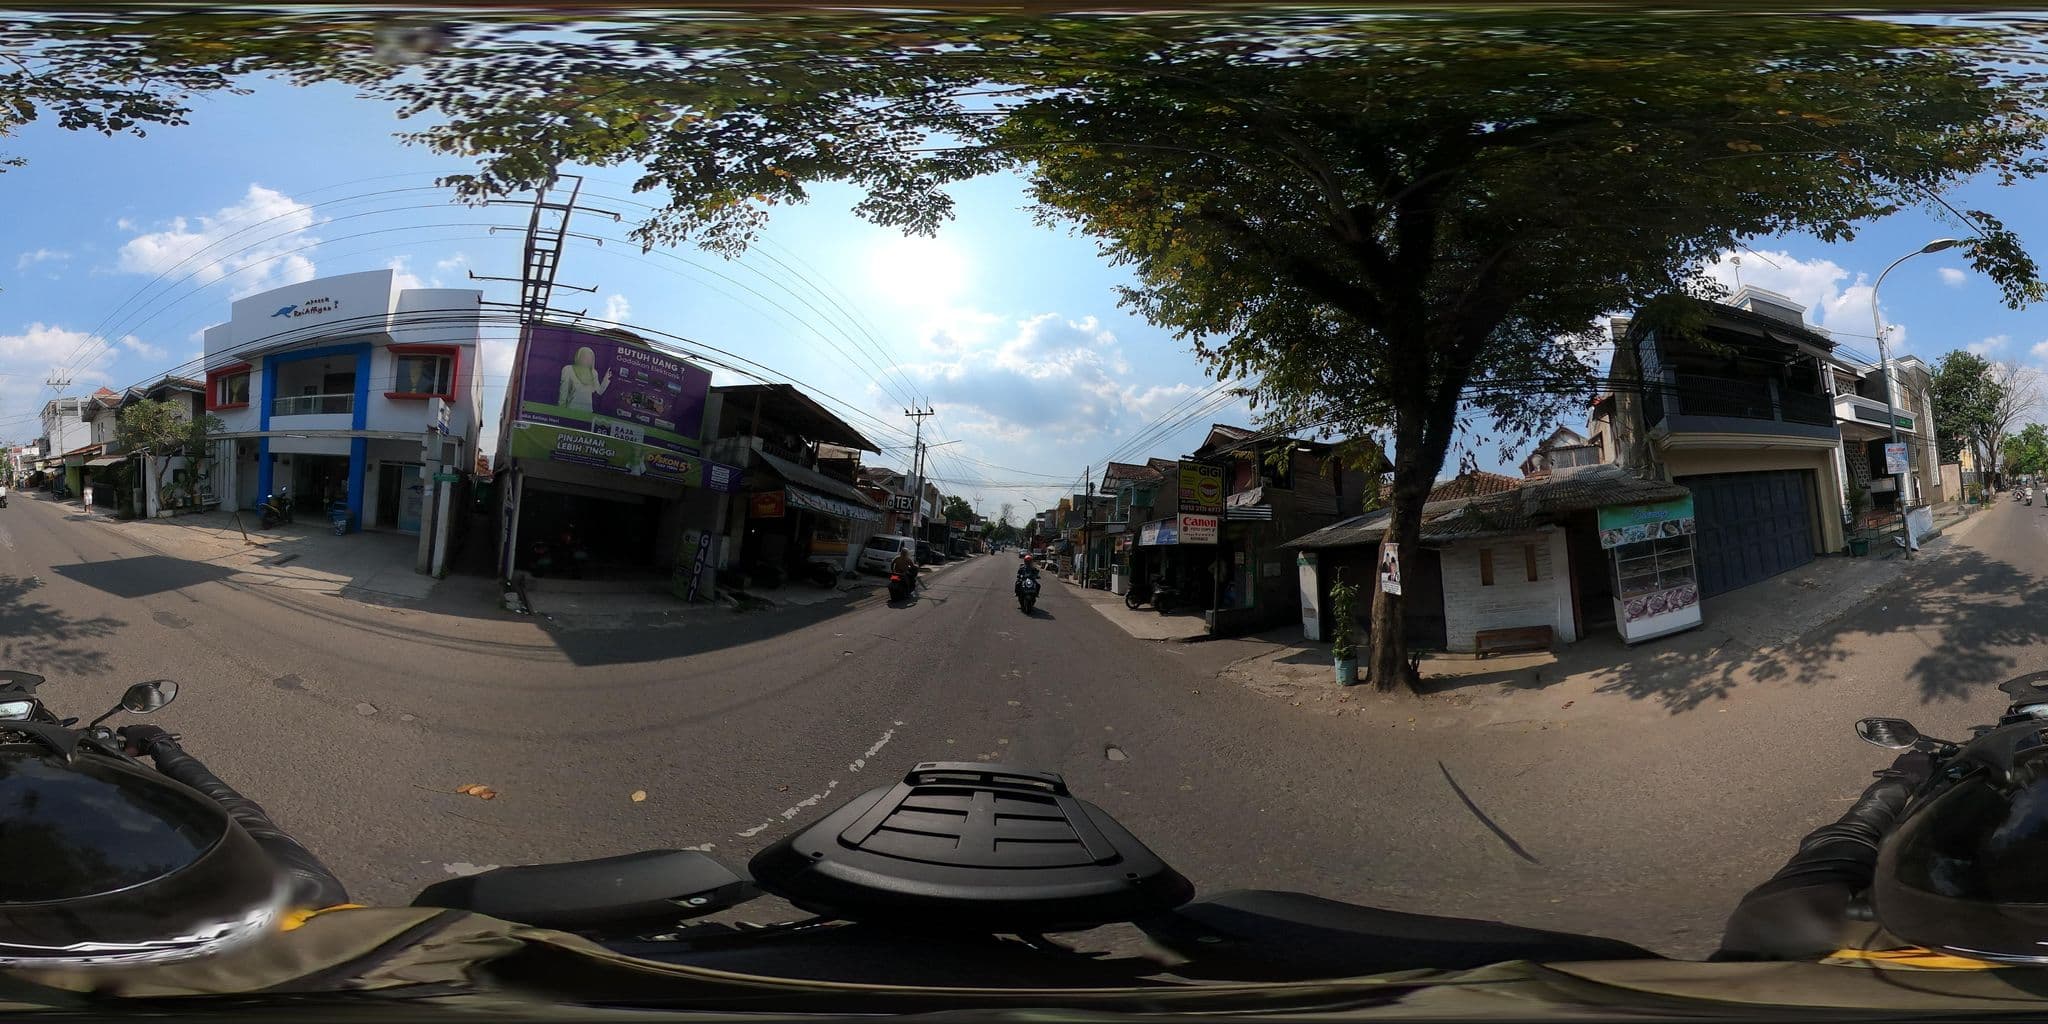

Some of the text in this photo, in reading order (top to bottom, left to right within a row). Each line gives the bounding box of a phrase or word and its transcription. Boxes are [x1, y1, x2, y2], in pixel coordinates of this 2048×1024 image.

[617, 346, 650, 362] BUTUH
[653, 357, 677, 372] UANG
[615, 426, 635, 438] RAJA
[557, 432, 606, 448] PINJAMAN
[557, 442, 582, 452] LEBIH
[1198, 465, 1223, 478] GIGI
[1182, 516, 1217, 528] Canon
[689, 533, 710, 601] GADAI
